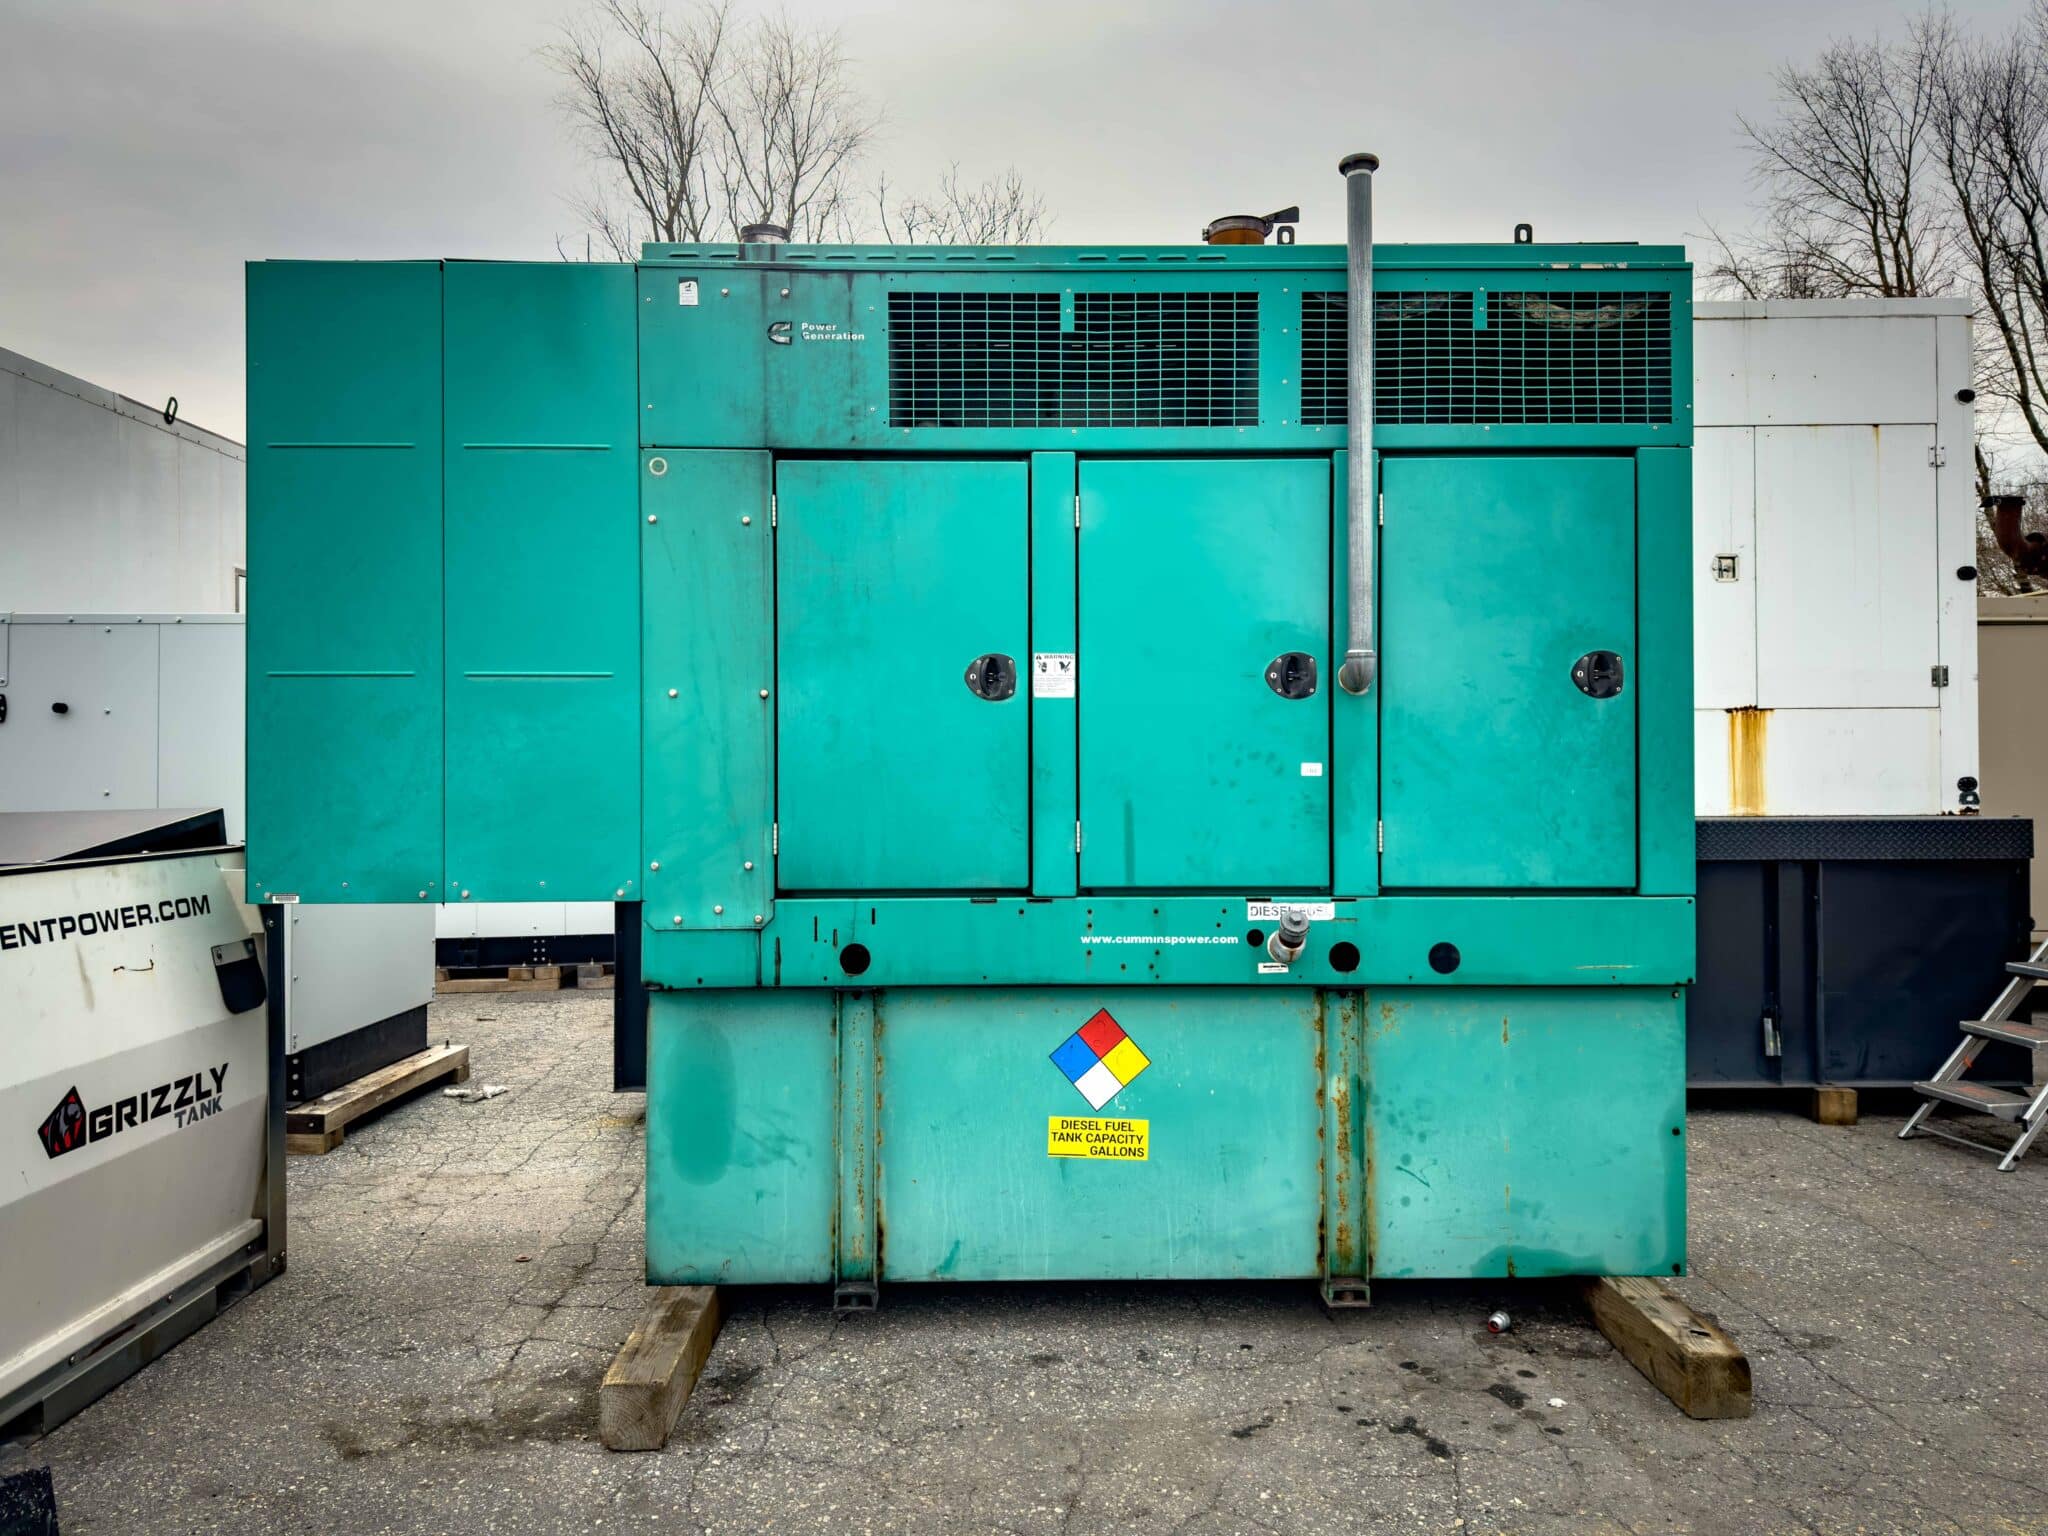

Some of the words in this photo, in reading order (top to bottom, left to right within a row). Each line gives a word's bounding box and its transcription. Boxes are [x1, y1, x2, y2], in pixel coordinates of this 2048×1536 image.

[801, 322, 837, 331] Power
[801, 332, 865, 341] Generation
[0, 895, 211, 950] ENTPOWER.COM
[1081, 935, 1239, 946] www.cumminspower.com
[88, 1063, 229, 1143] GRIZZLY
[175, 1096, 223, 1128] TANK
[1061, 1120, 1101, 1131] DIESEL
[1105, 1122, 1134, 1132] FUEL
[1052, 1132, 1082, 1142] TANK
[1086, 1133, 1143, 1144] CAPACITY
[1090, 1146, 1145, 1157] GALLONS
